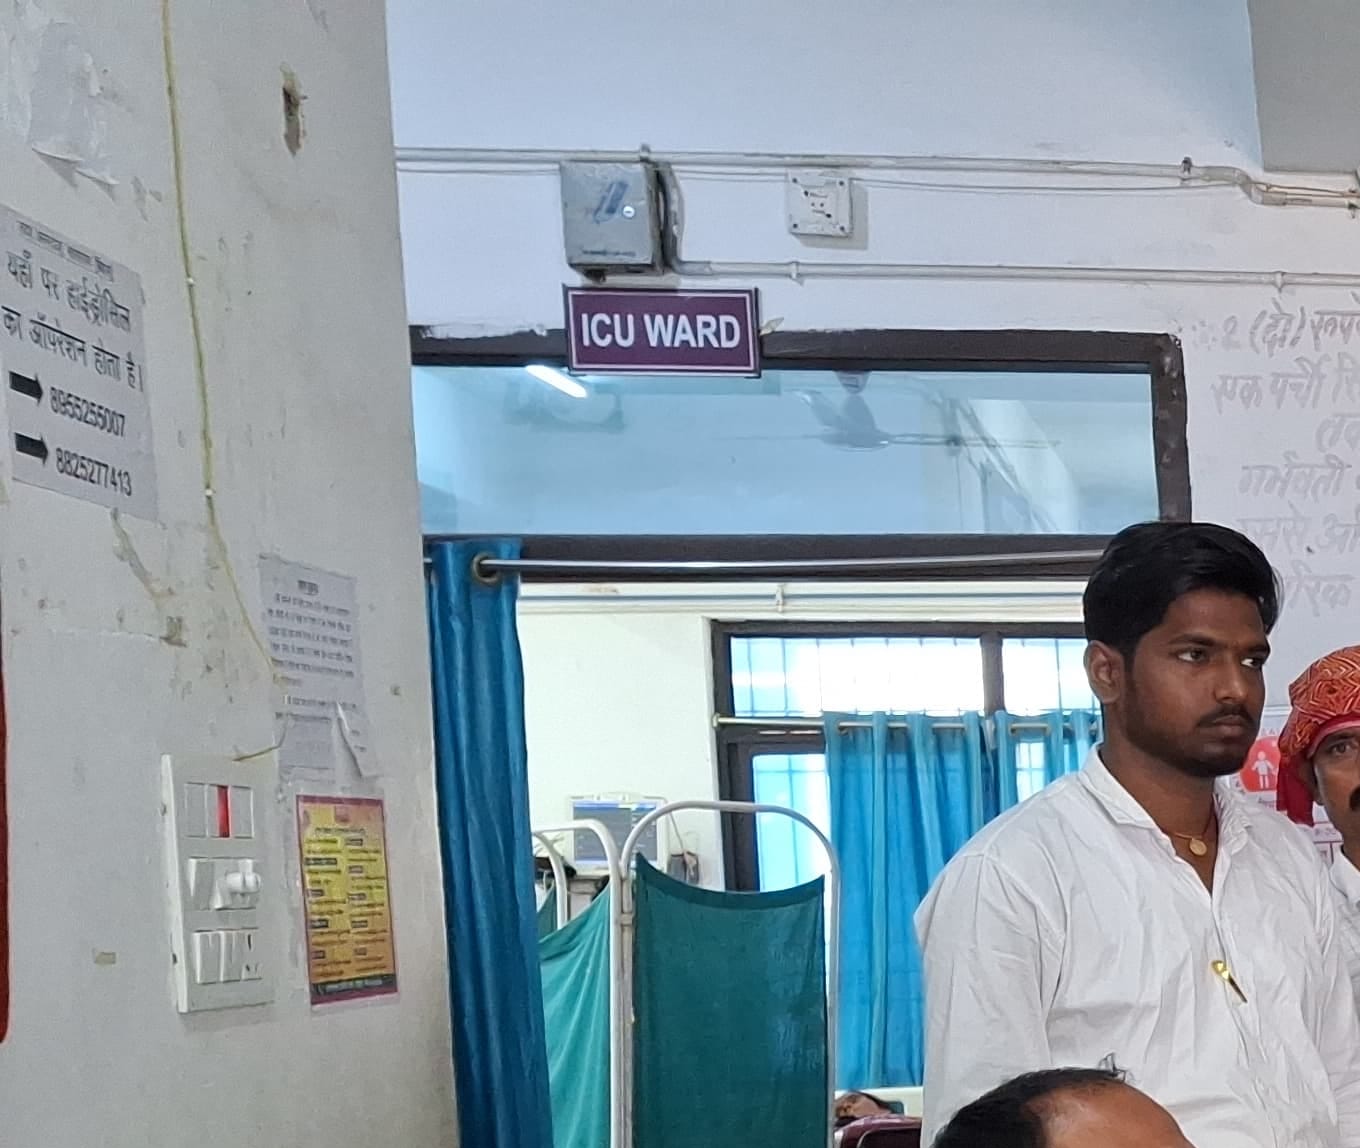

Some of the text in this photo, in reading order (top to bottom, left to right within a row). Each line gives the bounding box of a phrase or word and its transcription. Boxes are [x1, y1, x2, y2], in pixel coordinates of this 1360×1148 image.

[40, 267, 60, 301] पर
[581, 313, 741, 348] ICU WARD
